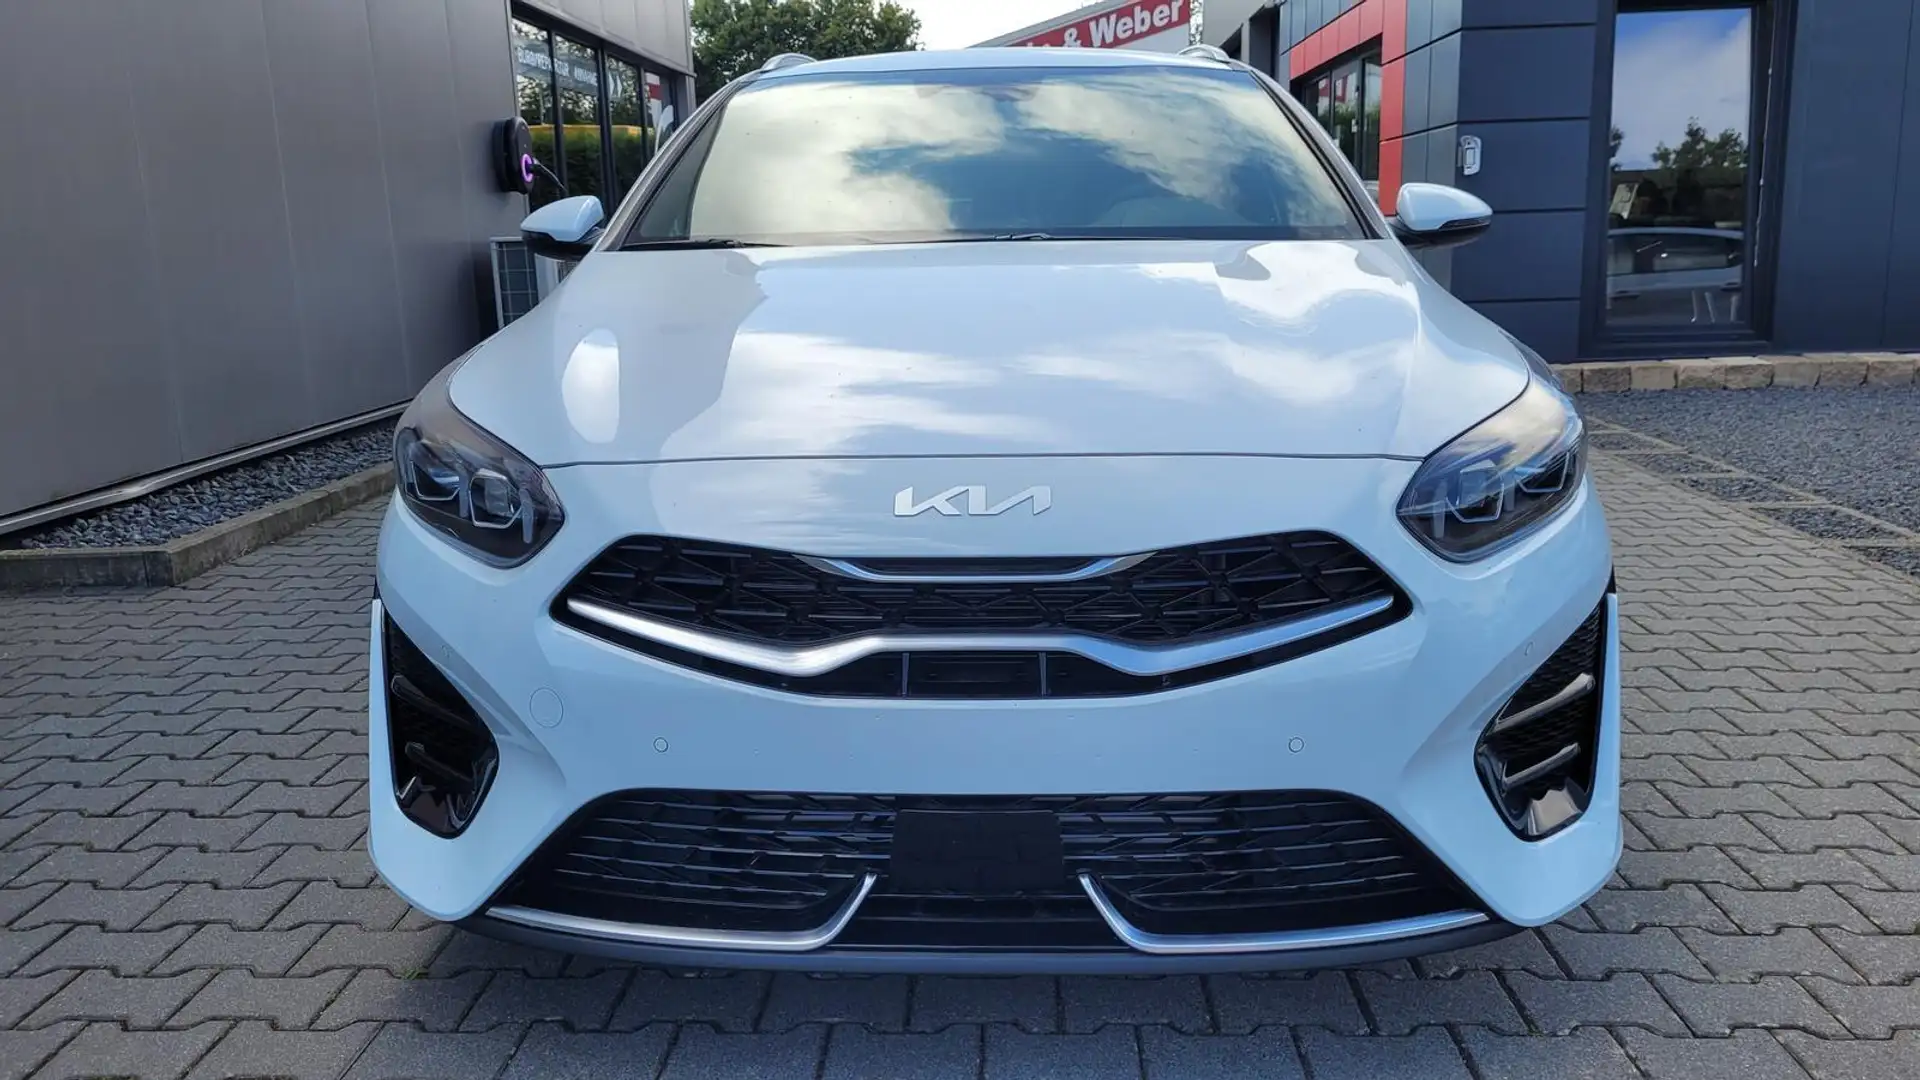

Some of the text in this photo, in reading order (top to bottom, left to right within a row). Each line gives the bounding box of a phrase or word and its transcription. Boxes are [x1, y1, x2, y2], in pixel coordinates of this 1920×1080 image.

[1062, 0, 1183, 48] & Weber
[895, 486, 1051, 516] KIA
